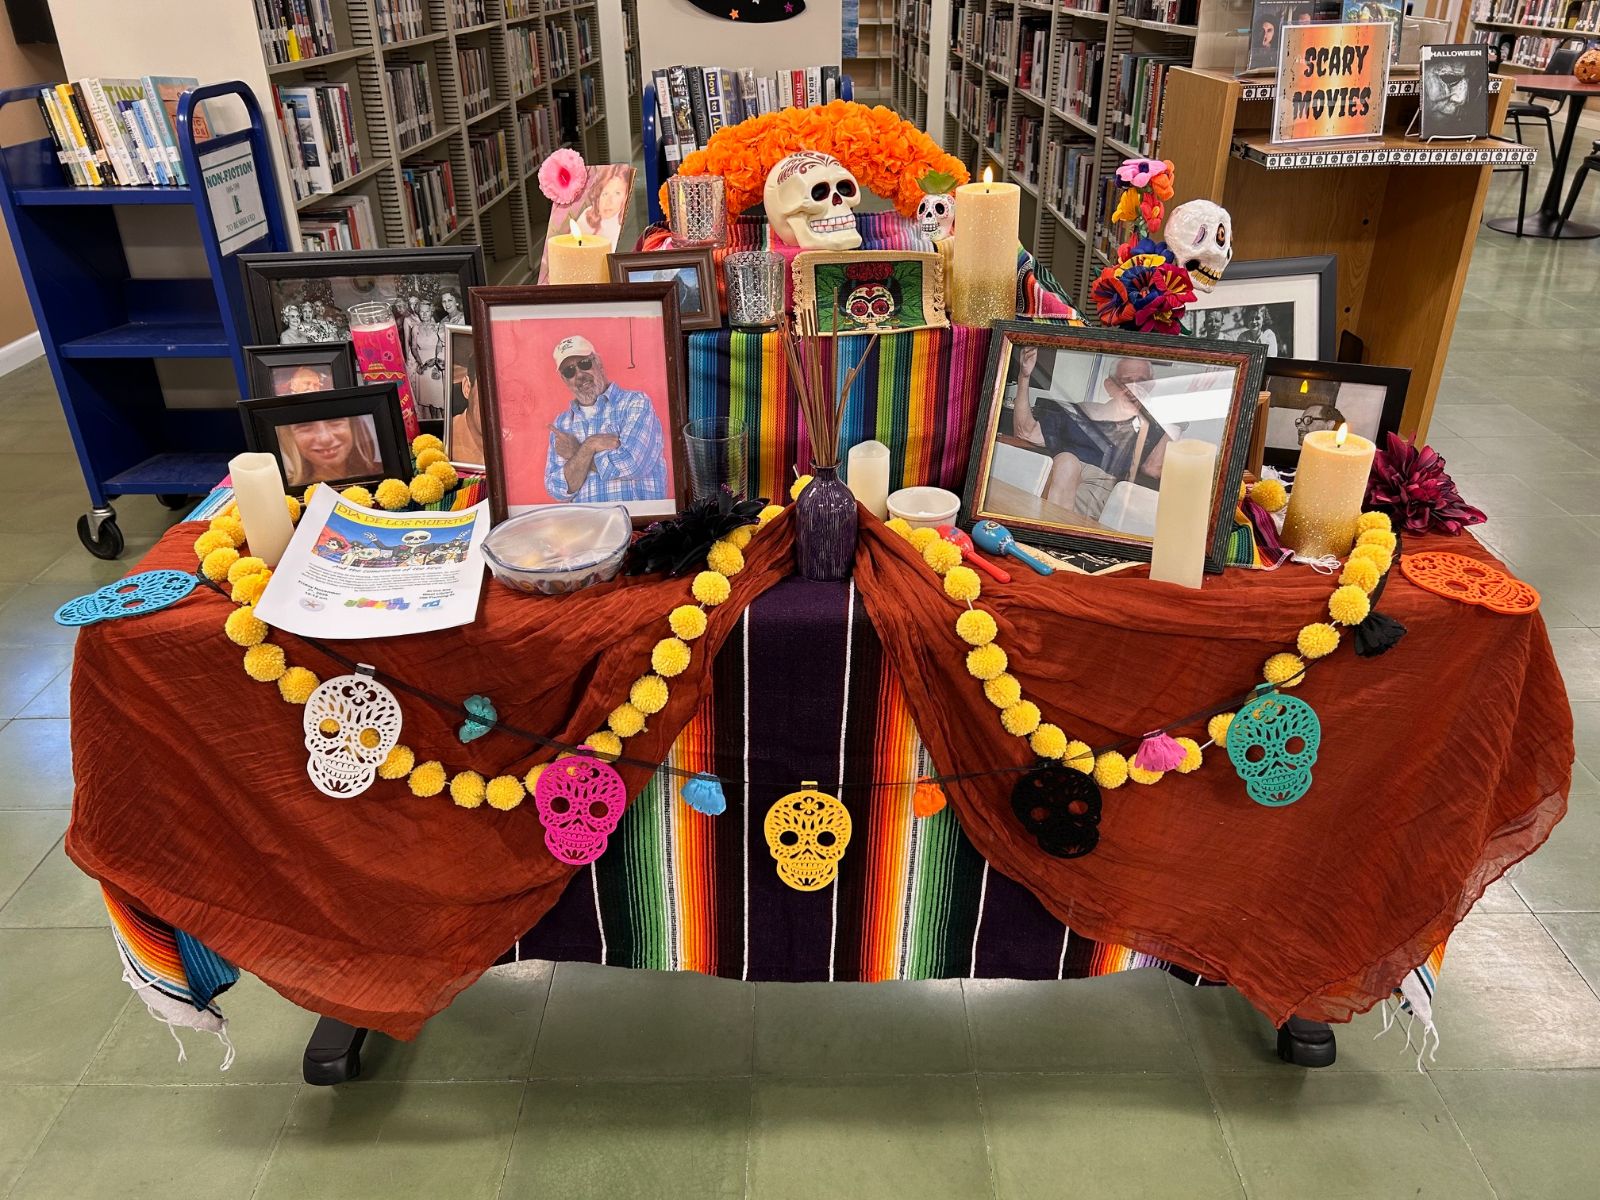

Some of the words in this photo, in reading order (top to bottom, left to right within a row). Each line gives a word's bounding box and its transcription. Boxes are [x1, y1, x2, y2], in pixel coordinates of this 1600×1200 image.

[1303, 45, 1369, 77] SCARY
[102, 86, 143, 106] TINY
[707, 73, 717, 96] How
[91, 81, 104, 102] TINY
[101, 104, 119, 138] HABITS
[711, 101, 718, 111] to
[1292, 86, 1372, 120] MOVIES
[205, 160, 253, 189] NON-FICTION
[365, 515, 383, 524] DE
[385, 518, 412, 526] LOS
[415, 514, 475, 526] MUERTOS
